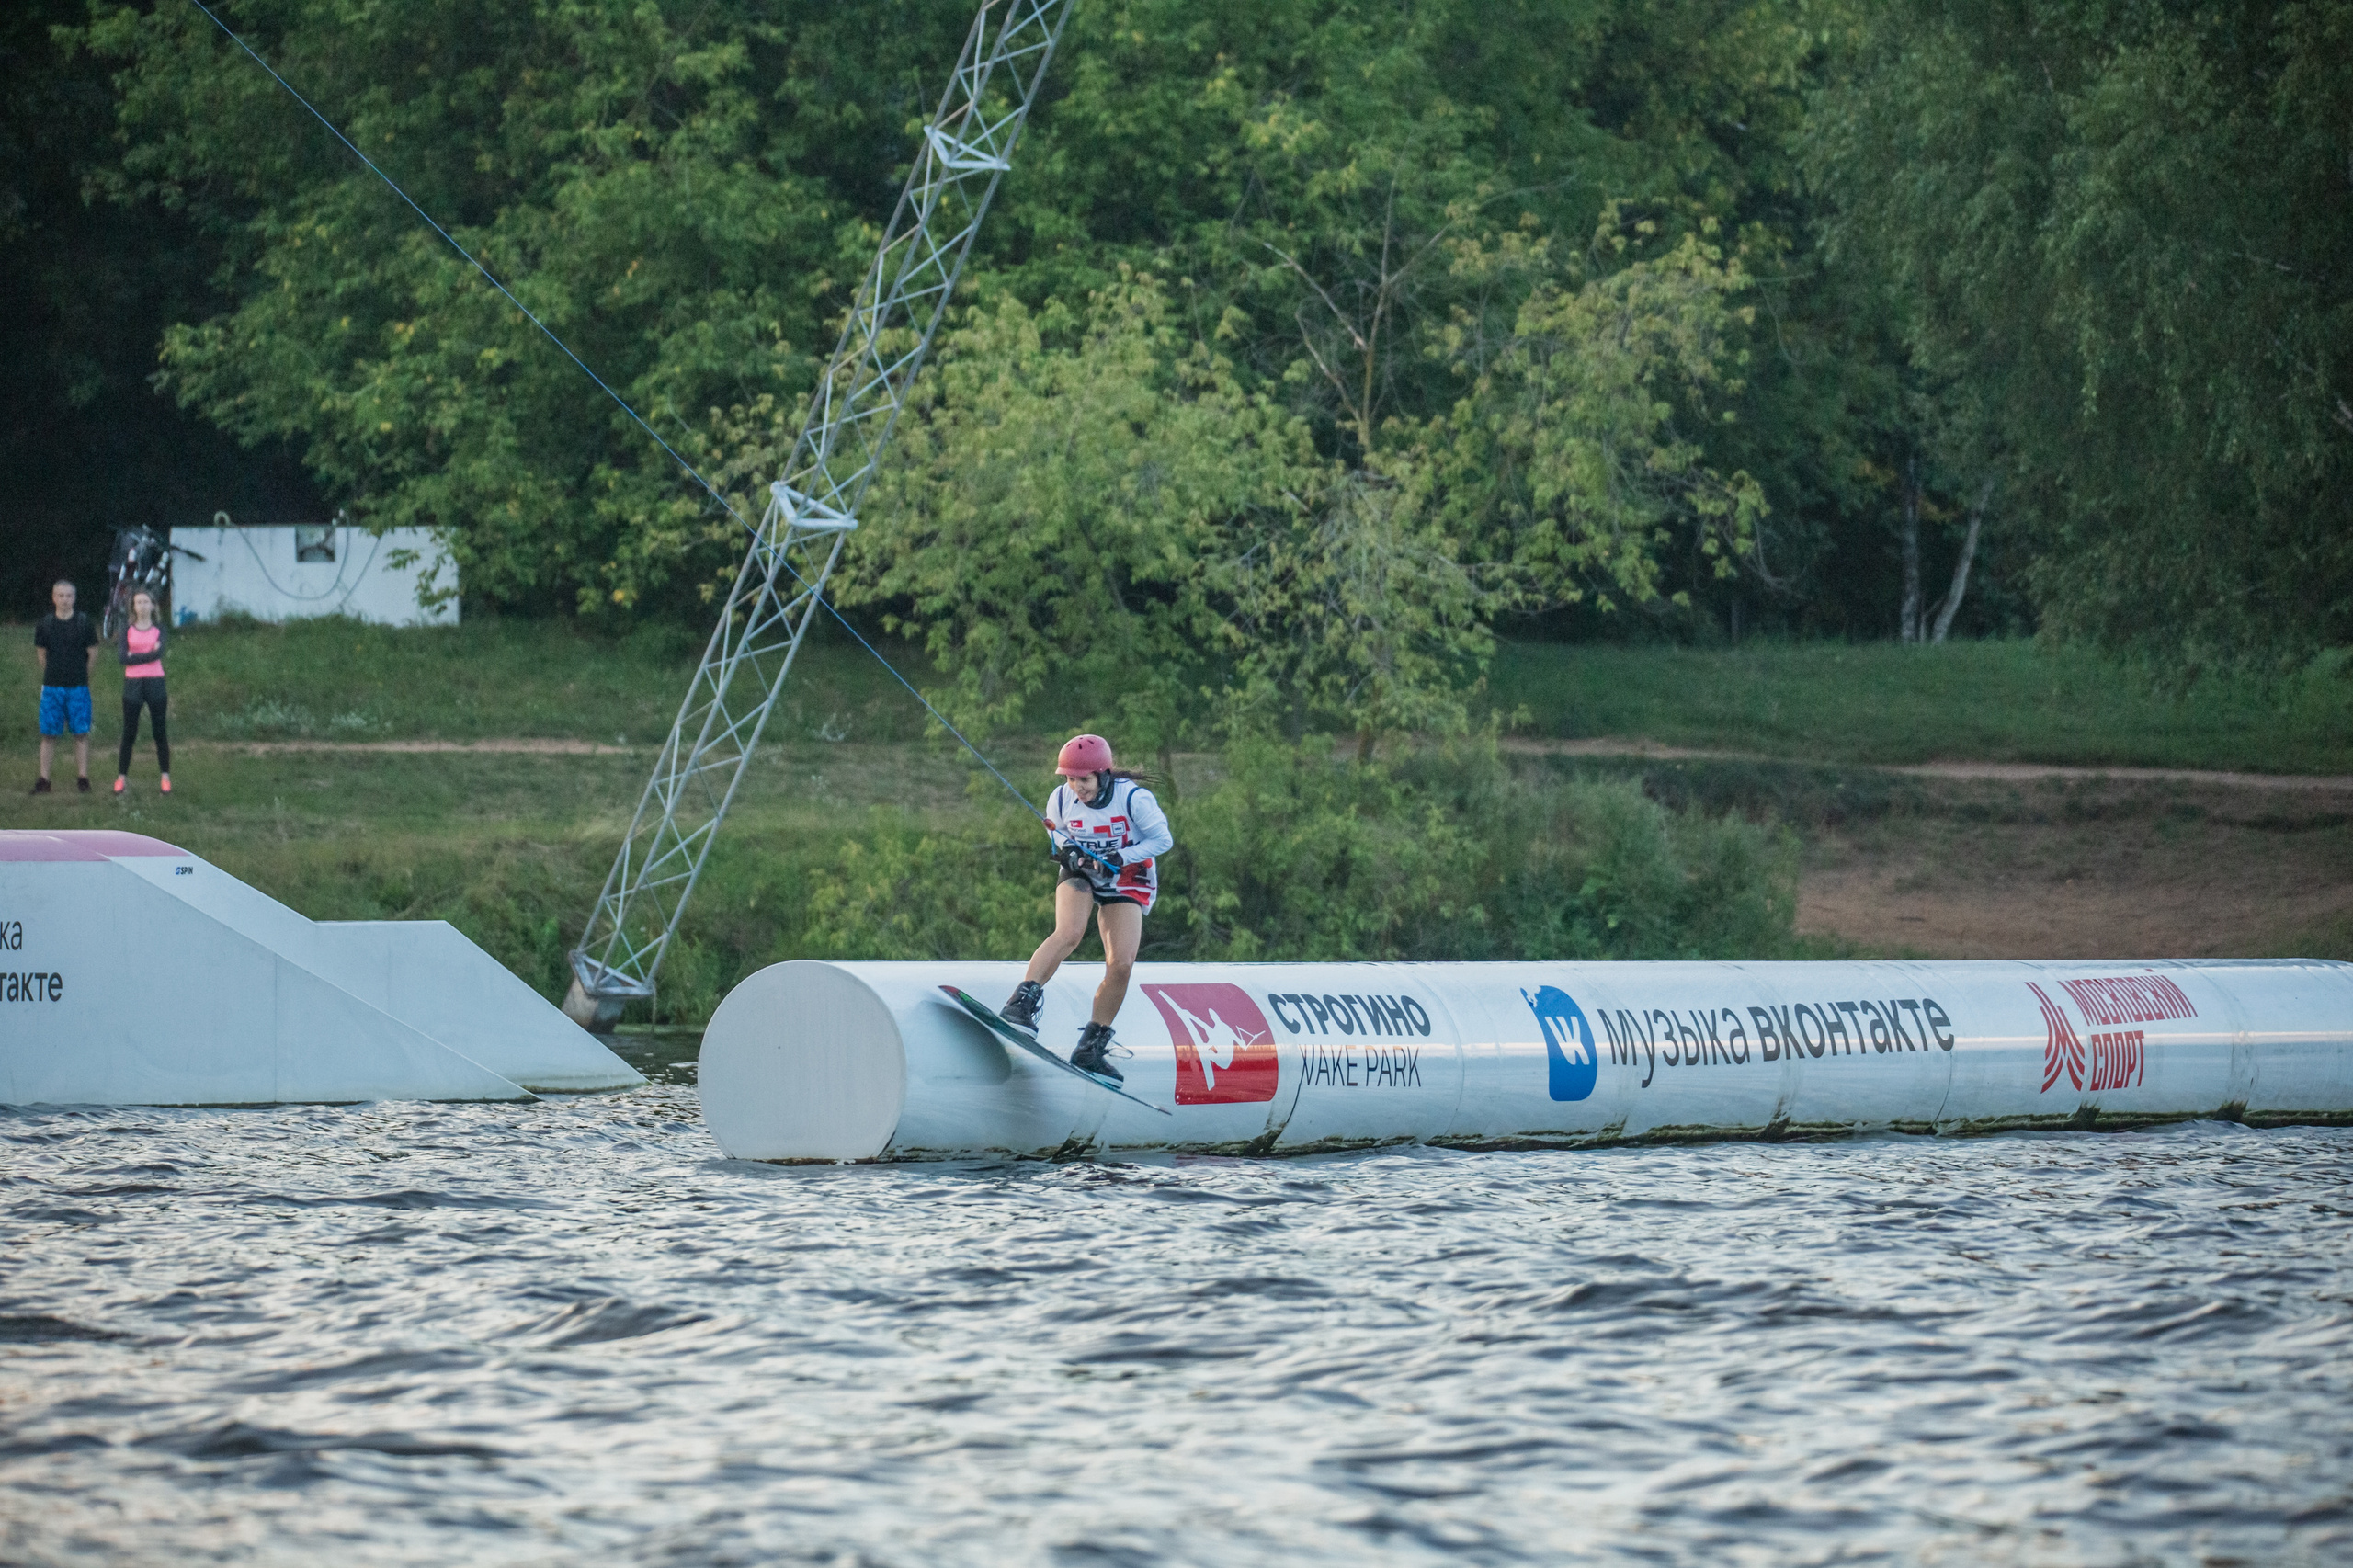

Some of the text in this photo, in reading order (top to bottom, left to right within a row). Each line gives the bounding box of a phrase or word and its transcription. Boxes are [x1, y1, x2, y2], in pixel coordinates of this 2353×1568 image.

[1267, 993, 1431, 1037] СТРОГИНО
[1364, 1044, 1422, 1087] PARK
[2089, 1029, 2144, 1091] СПОРТ
